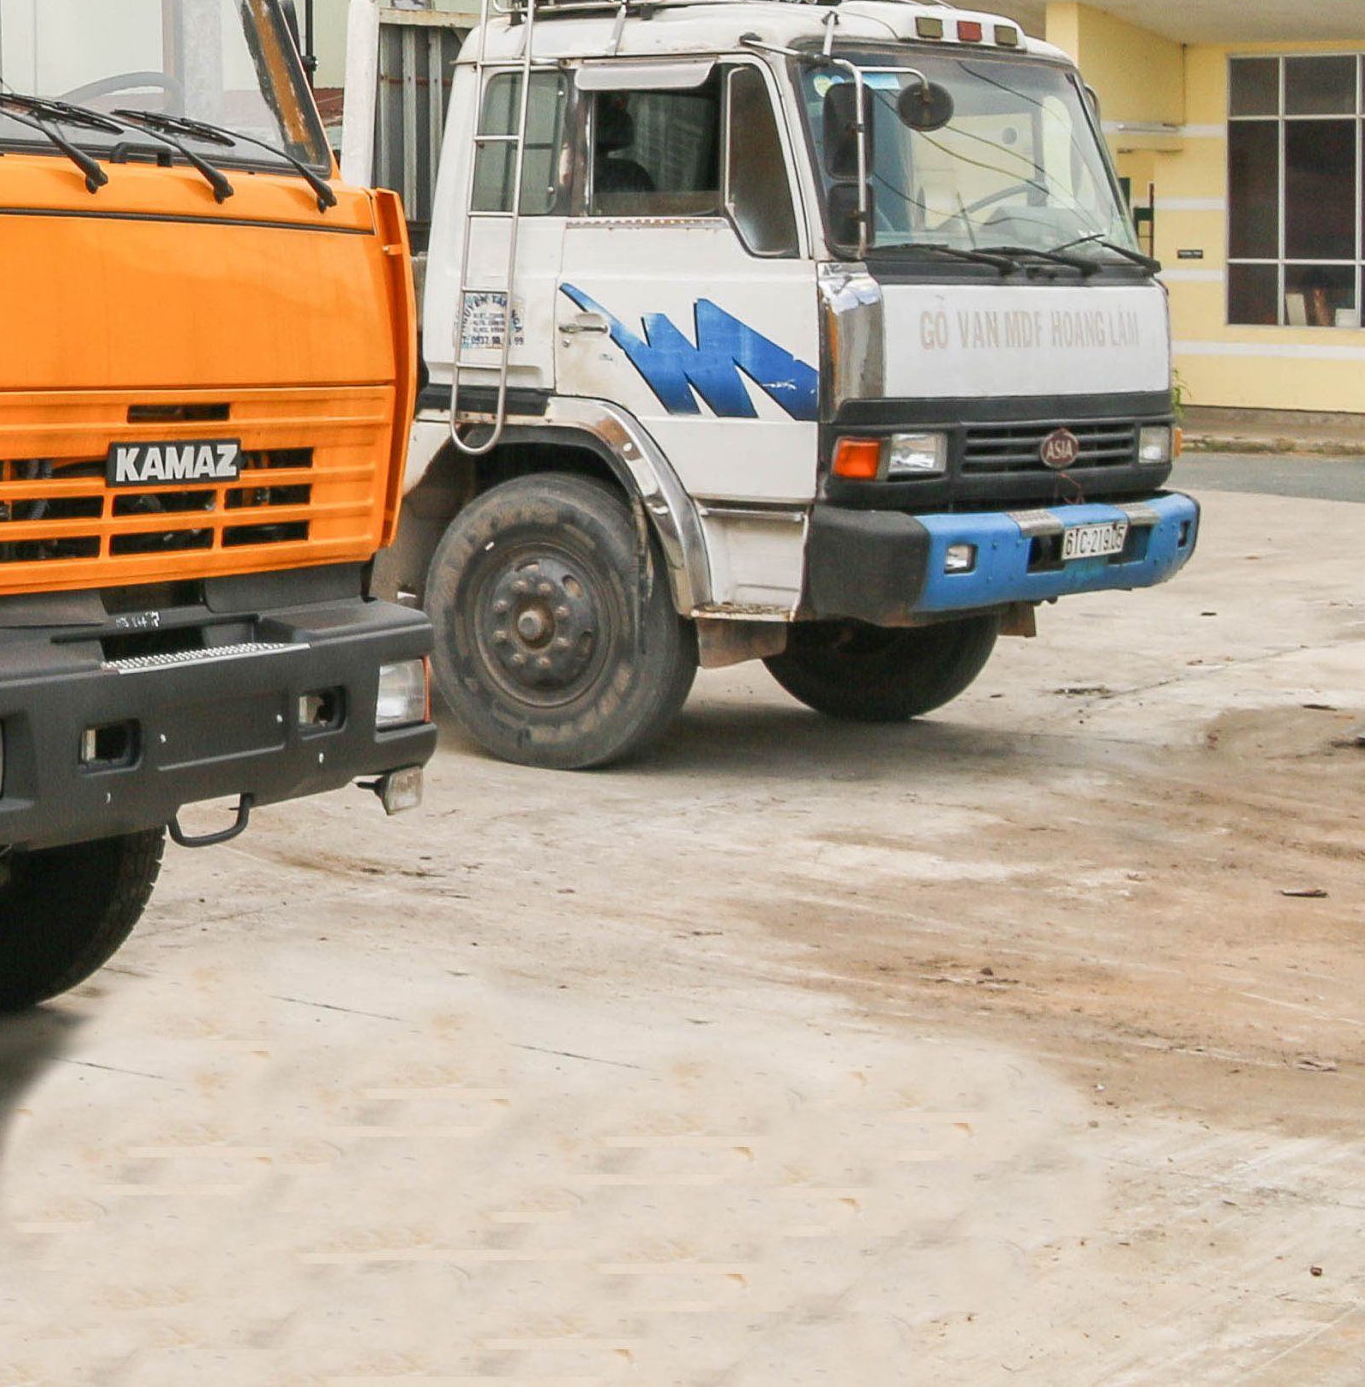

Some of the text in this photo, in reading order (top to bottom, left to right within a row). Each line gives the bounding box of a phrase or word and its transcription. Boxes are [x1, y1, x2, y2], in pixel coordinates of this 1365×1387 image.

[1004, 310, 1042, 349] MDF
[115, 443, 238, 483] KAMAZ
[1045, 439, 1074, 460] ASIA
